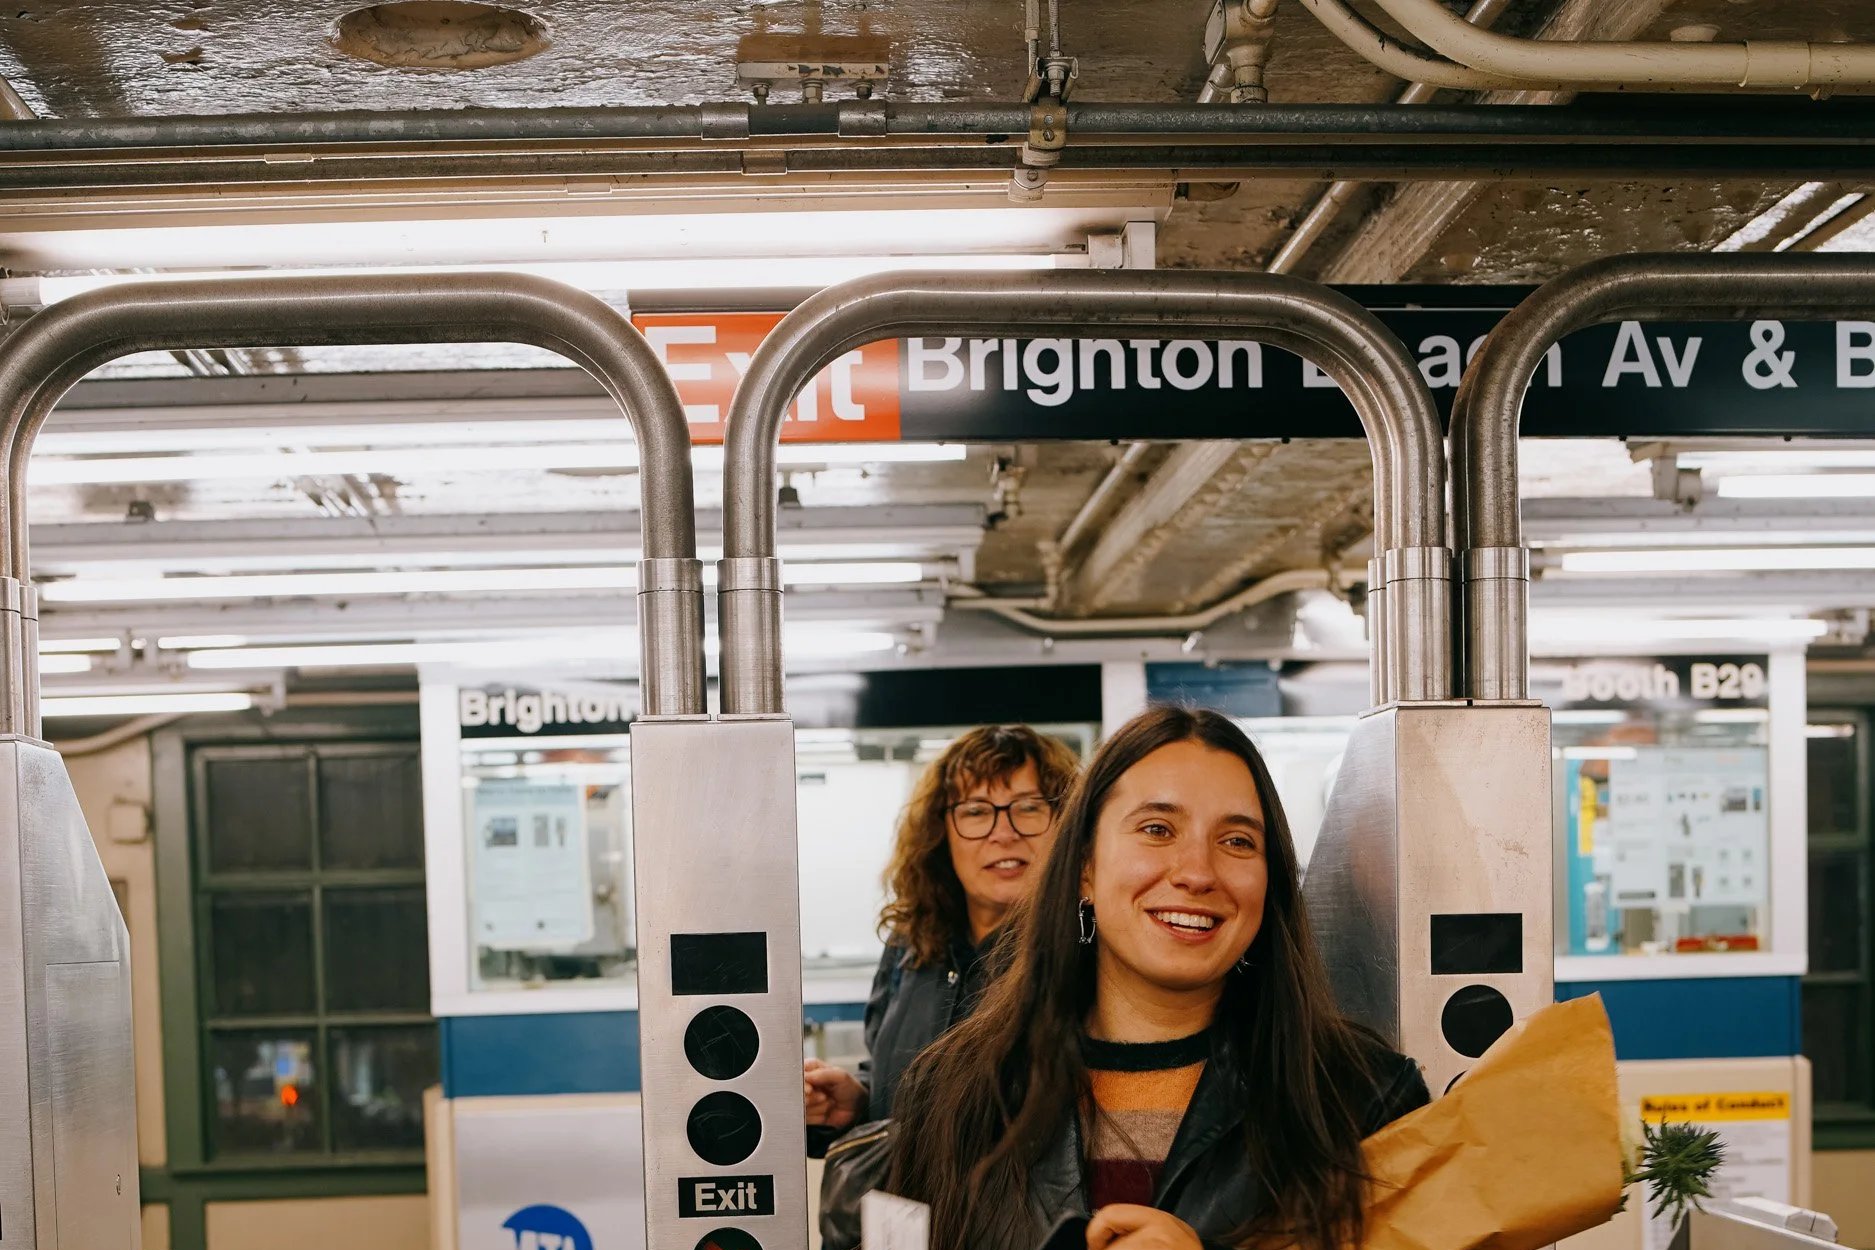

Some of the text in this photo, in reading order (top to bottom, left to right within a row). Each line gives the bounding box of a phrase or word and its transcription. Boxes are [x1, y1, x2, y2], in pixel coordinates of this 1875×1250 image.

[645, 325, 865, 423] Eit
[908, 338, 1263, 406] Brighton
[1602, 320, 1703, 387] Av
[1742, 320, 1799, 389] &
[460, 689, 634, 733] Brighton
[694, 1181, 757, 1212] Exit
